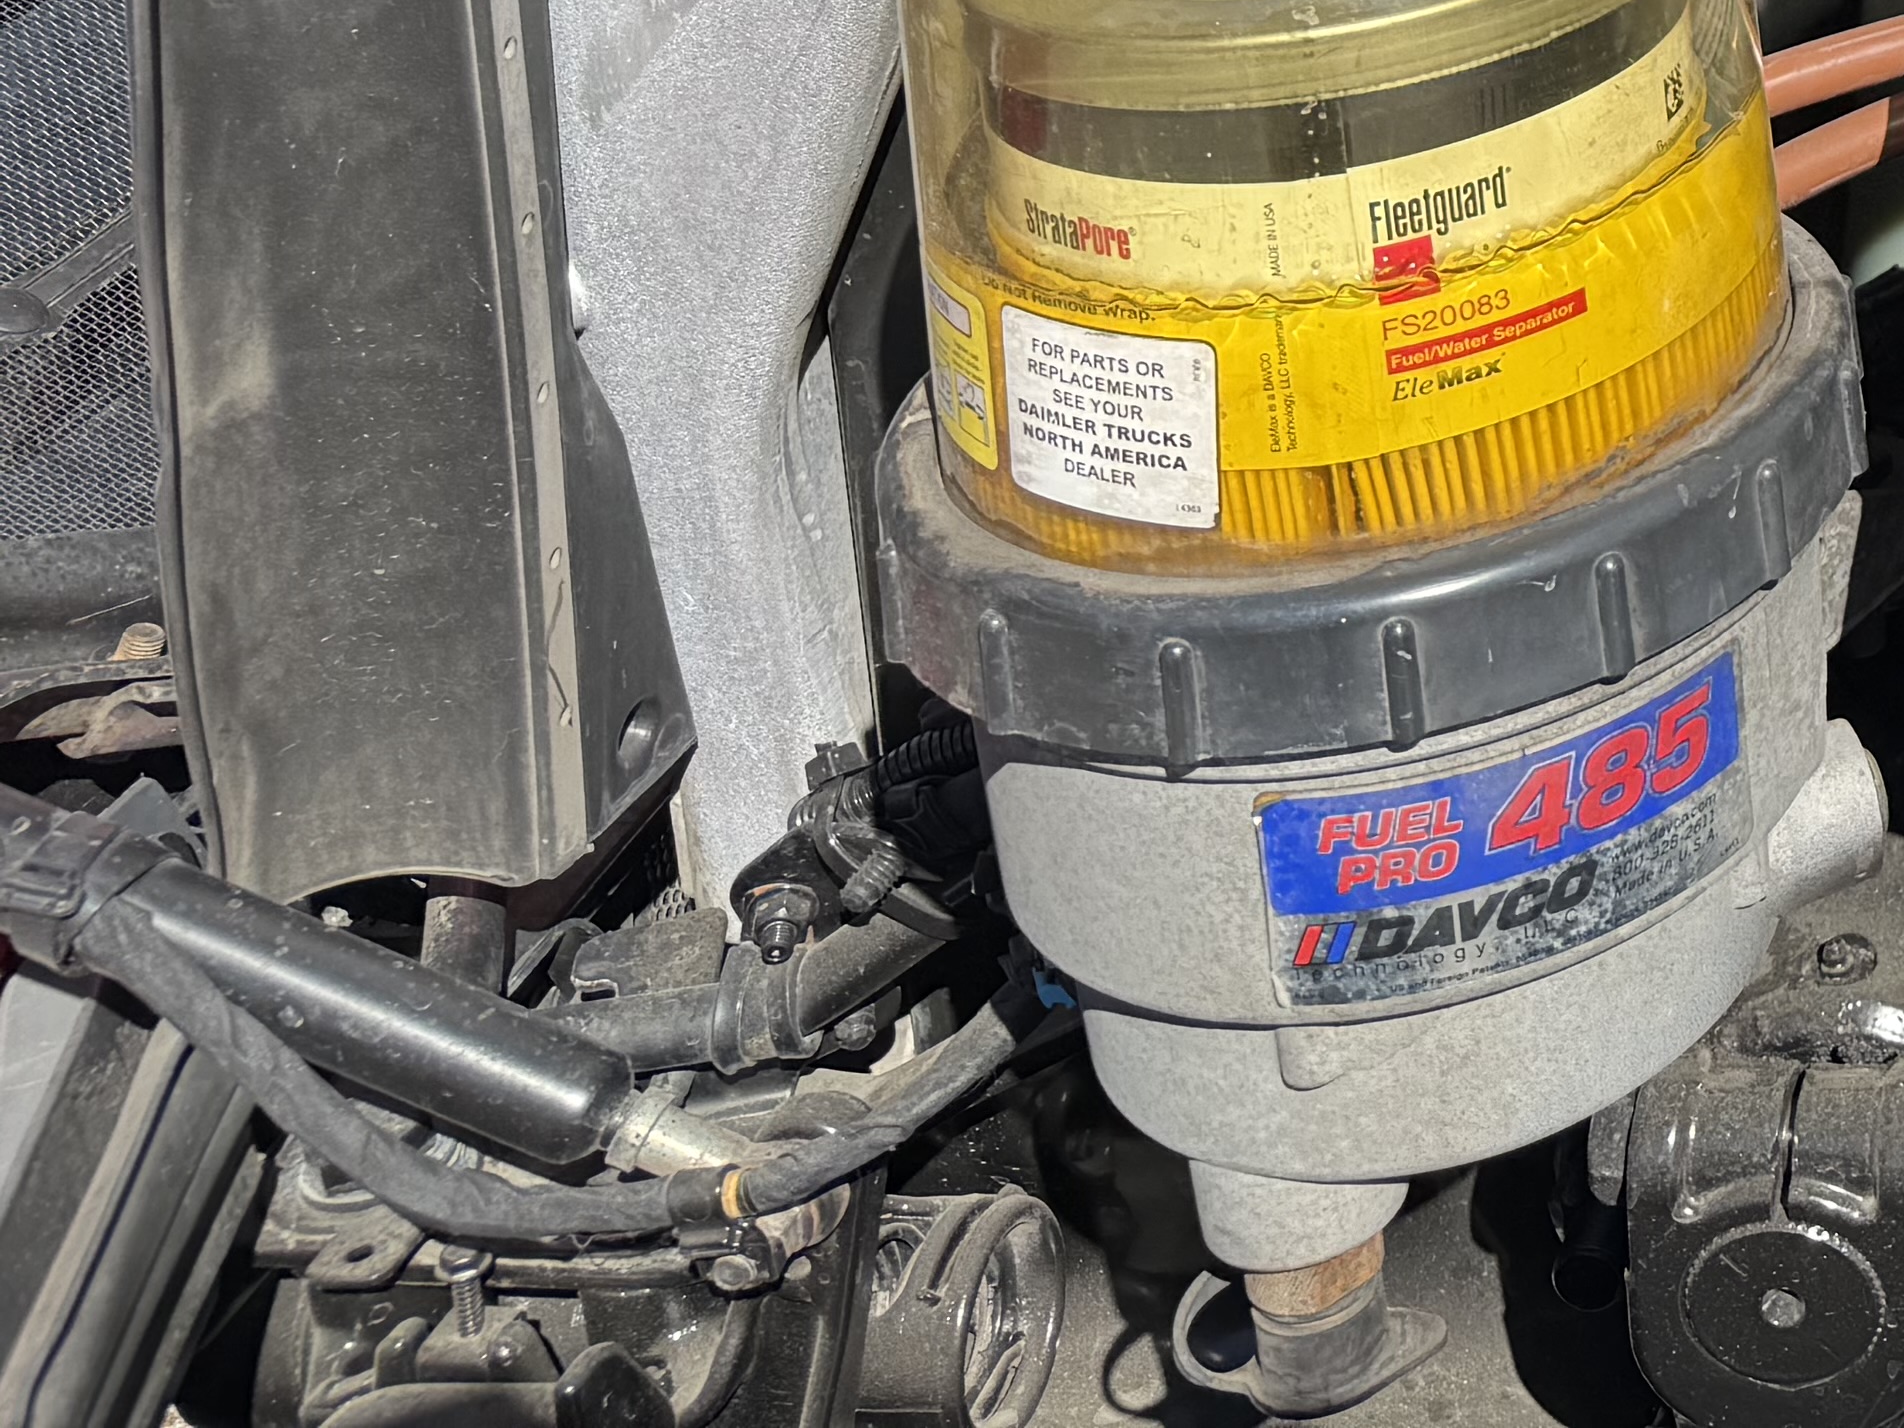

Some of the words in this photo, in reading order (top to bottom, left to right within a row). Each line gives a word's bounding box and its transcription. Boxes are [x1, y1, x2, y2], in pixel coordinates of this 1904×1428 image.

[1263, 202, 1277, 227] USA
[1368, 164, 1511, 245] Fleetguard
[1266, 229, 1279, 242] IN
[1269, 244, 1285, 279] MADE
[1032, 290, 1098, 316] Remove
[1103, 303, 1157, 325] Wrap.
[1381, 288, 1513, 342] FS20083
[1389, 333, 1490, 372] Fuel/Water
[1491, 299, 1577, 344] Separator
[1027, 357, 1174, 402] REPLACEMENTS
[1032, 337, 1066, 362] FOR
[1069, 348, 1130, 374] PARTS
[1135, 360, 1165, 379] OR
[1259, 352, 1274, 392] DAVCO
[1276, 367, 1291, 390] LLC
[1018, 397, 1097, 436] DAIMLER
[1103, 423, 1193, 449] TRUCKS
[1052, 388, 1085, 412] SEE
[1089, 397, 1144, 422] YOUR
[1023, 422, 1084, 455] NORTH
[1090, 443, 1188, 472] AMERICA
[1063, 457, 1137, 489] DEALER
[1485, 678, 1713, 855] 485
[1317, 796, 1464, 855] FUEL
[1609, 791, 1718, 862] www.davco.com
[1610, 810, 1716, 883] 800-328-2611
[1336, 839, 1461, 896] PRO
[1612, 868, 1654, 900] Made
[1354, 858, 1599, 963] DAVCO
[1292, 942, 1488, 983] Technology
[1429, 970, 1470, 988] Foreign
